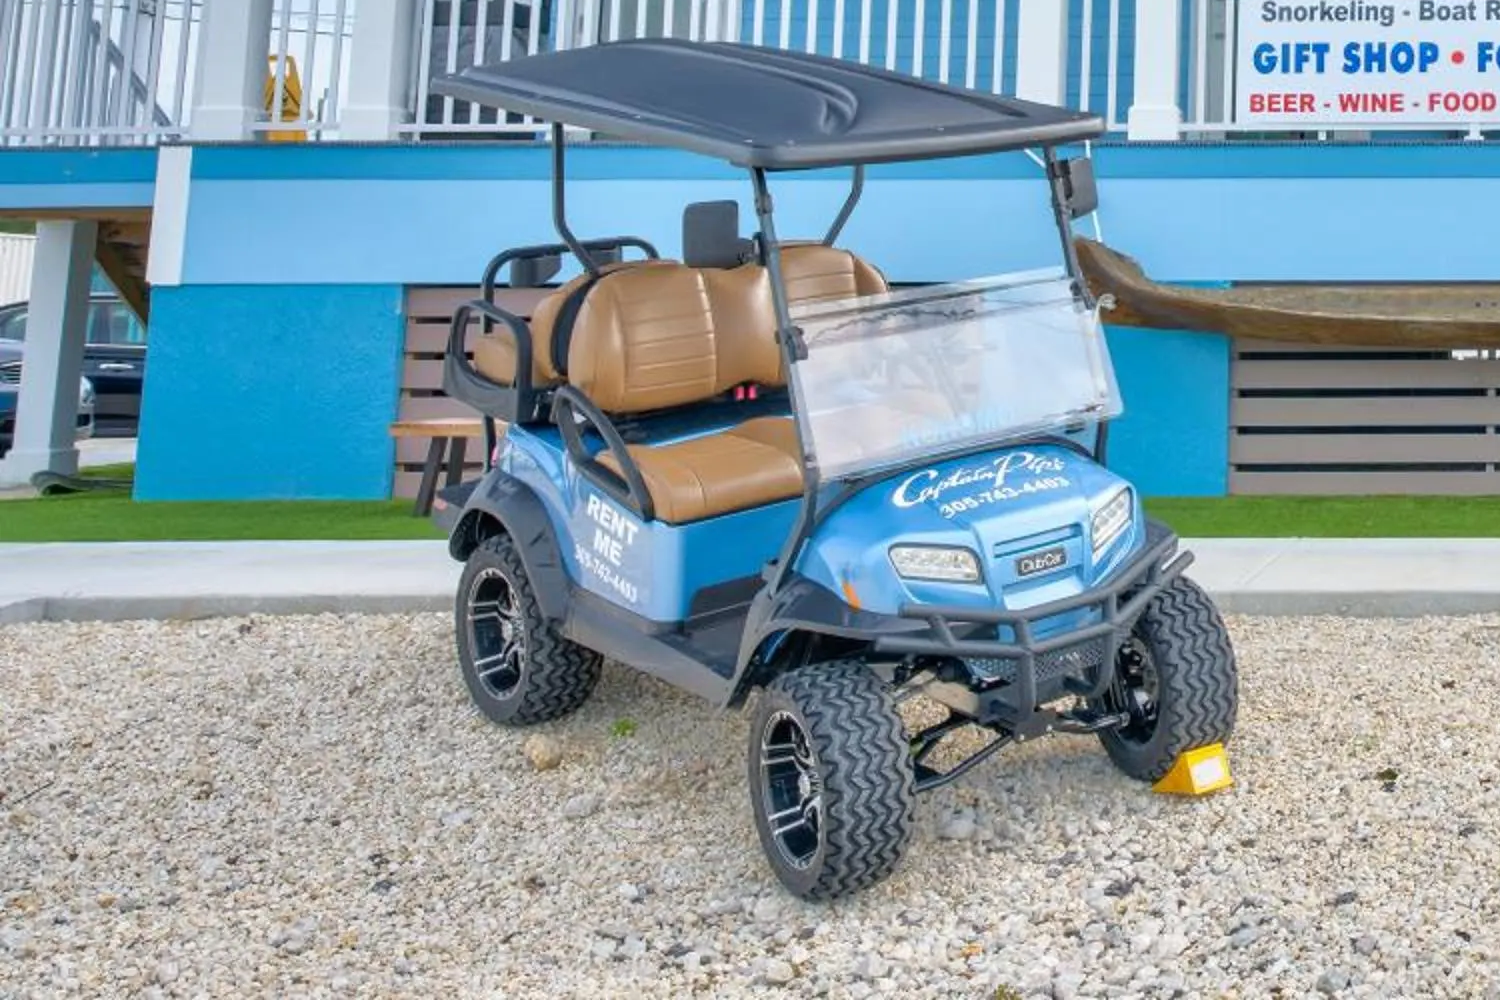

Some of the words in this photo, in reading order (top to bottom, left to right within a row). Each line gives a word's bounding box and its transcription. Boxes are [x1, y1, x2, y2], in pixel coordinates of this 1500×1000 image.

[1261, 0, 1395, 26] Snorkeling
[1419, 0, 1477, 21] Boat
[1253, 42, 1331, 74] GIFT
[1342, 42, 1439, 74] SHOP
[1249, 93, 1316, 113] BEER
[1338, 93, 1405, 112] WINE
[1428, 92, 1497, 112] FOOD
[892, 466, 996, 508] Captain
[587, 493, 639, 545] RENT
[593, 527, 622, 566] ME
